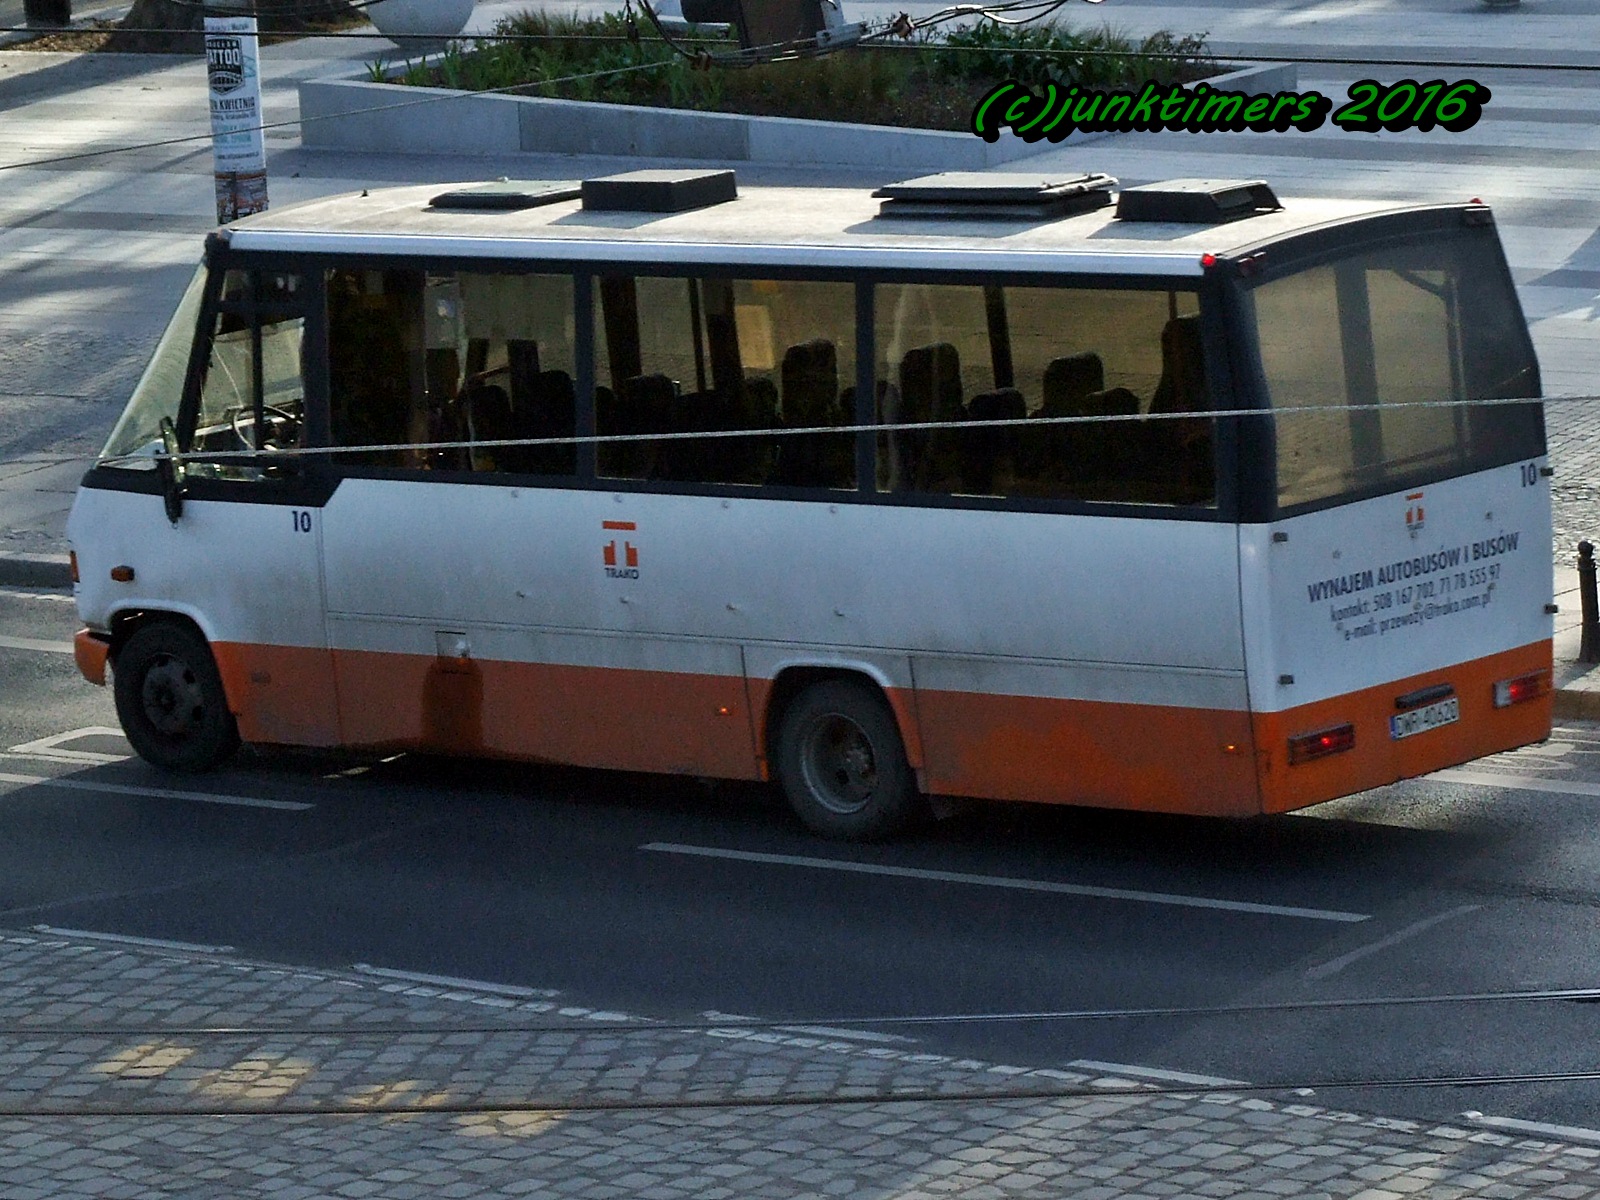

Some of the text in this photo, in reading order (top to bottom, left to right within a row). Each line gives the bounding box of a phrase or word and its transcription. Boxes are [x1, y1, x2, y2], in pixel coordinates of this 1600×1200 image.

[1520, 463, 1537, 487] 10
[292, 511, 311, 532] 10
[604, 567, 639, 579] TRAKO
[1307, 530, 1520, 602] WYNAJEM AUTOBUSÓW I BUSÓW
[1469, 568, 1487, 587] 555
